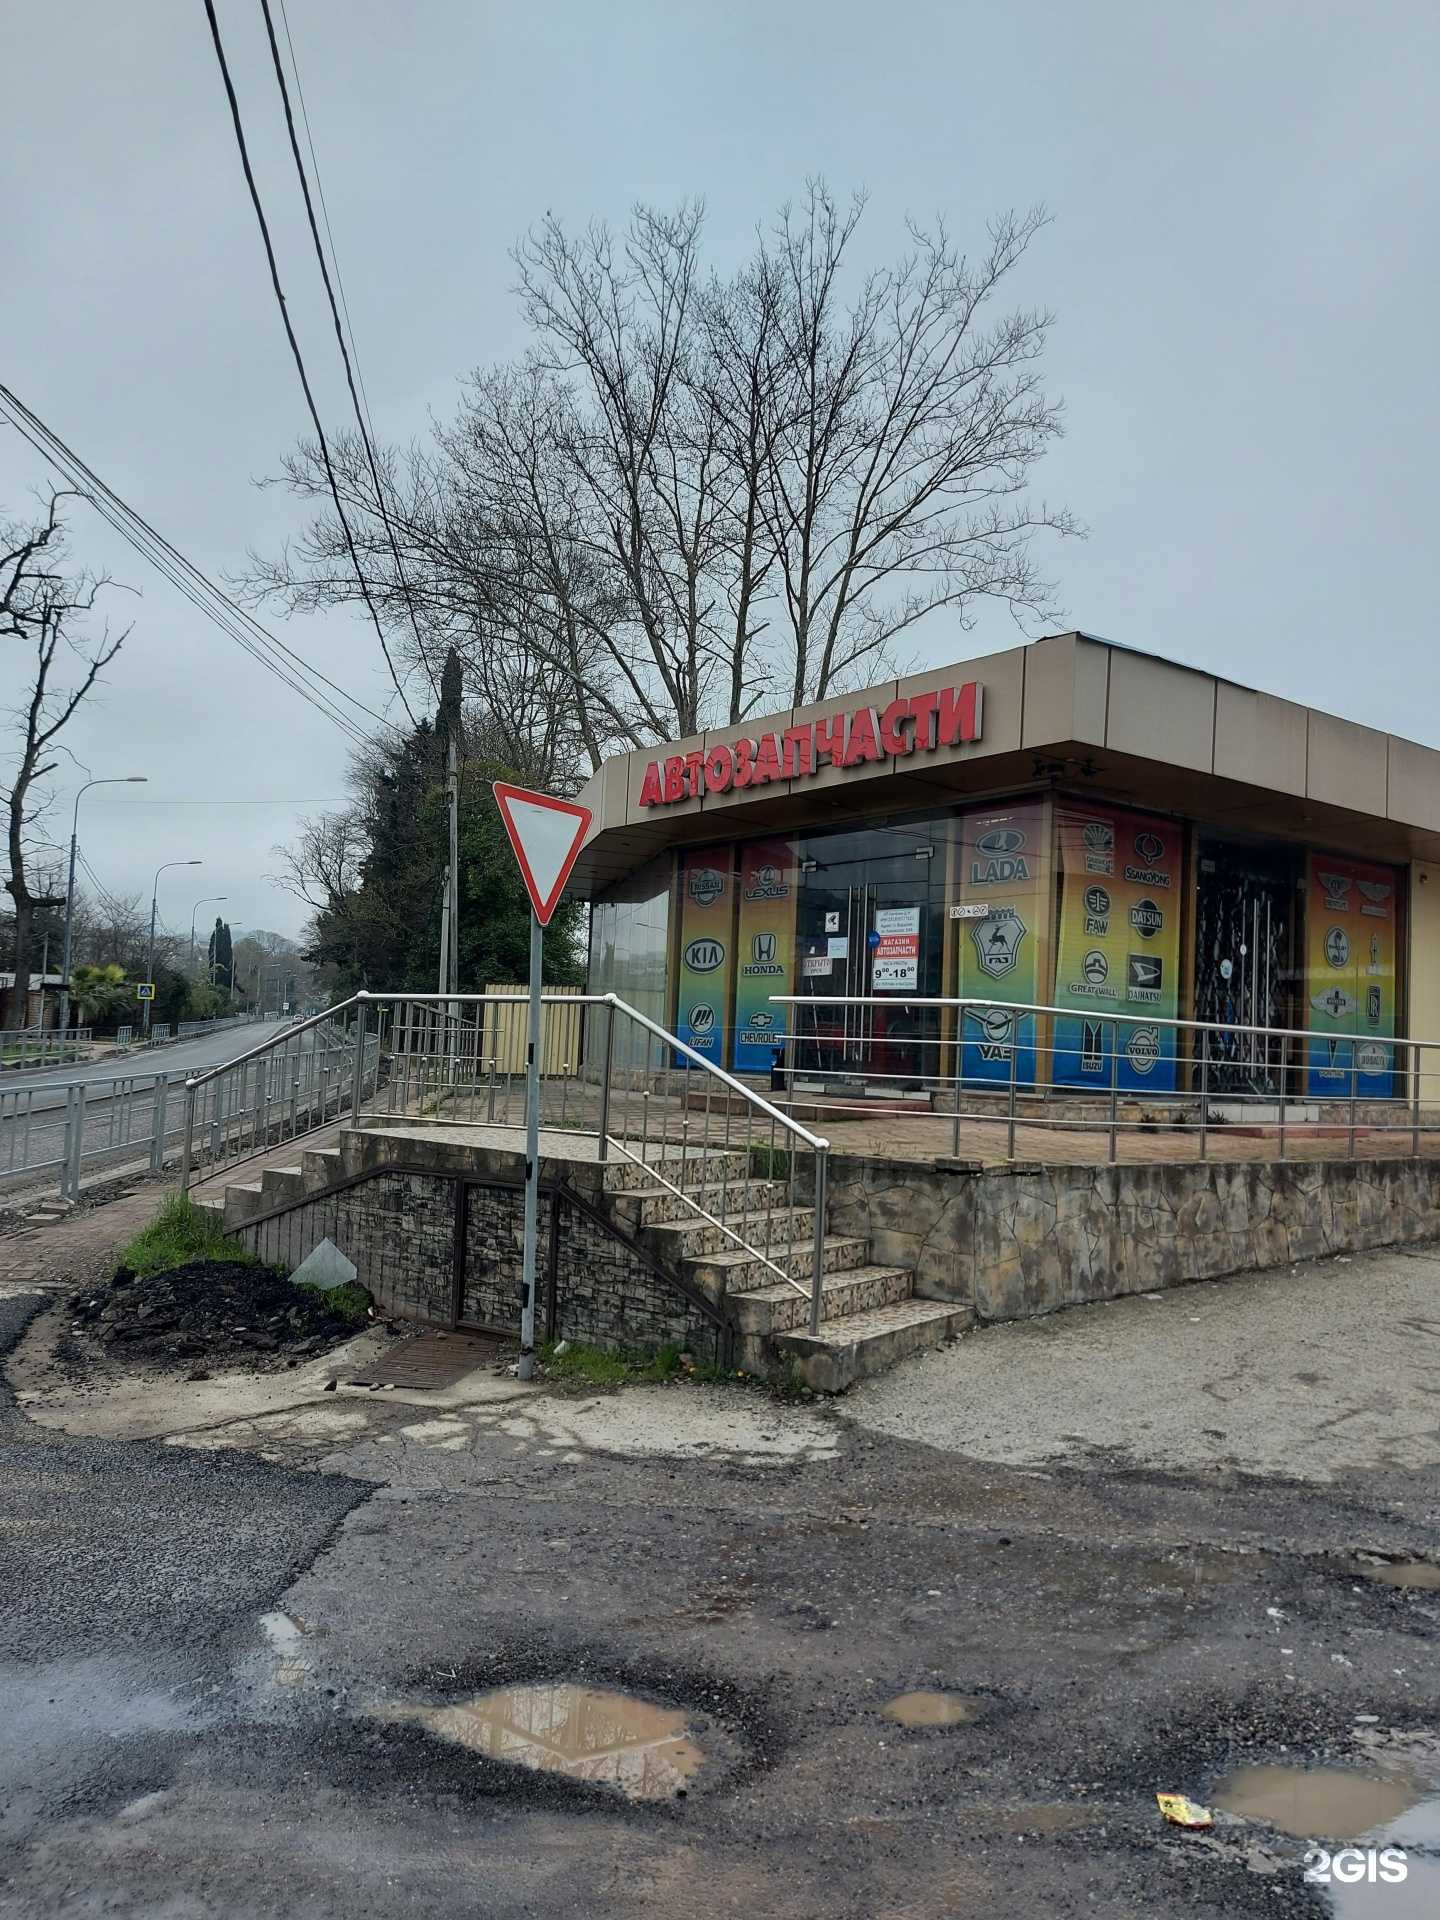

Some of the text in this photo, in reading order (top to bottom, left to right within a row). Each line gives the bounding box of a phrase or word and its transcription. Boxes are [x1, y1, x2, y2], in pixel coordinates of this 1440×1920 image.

[638, 681, 984, 807] АВТОЗАПЧАСТИ
[972, 858, 1029, 881] LADA
[745, 885, 789, 899] LEXUS
[1086, 918, 1108, 935] FAW
[1131, 910, 1162, 928] DATSUN
[692, 946, 719, 964] KIA
[744, 965, 784, 975] HONDA
[1129, 1046, 1158, 1056] VOLVO
